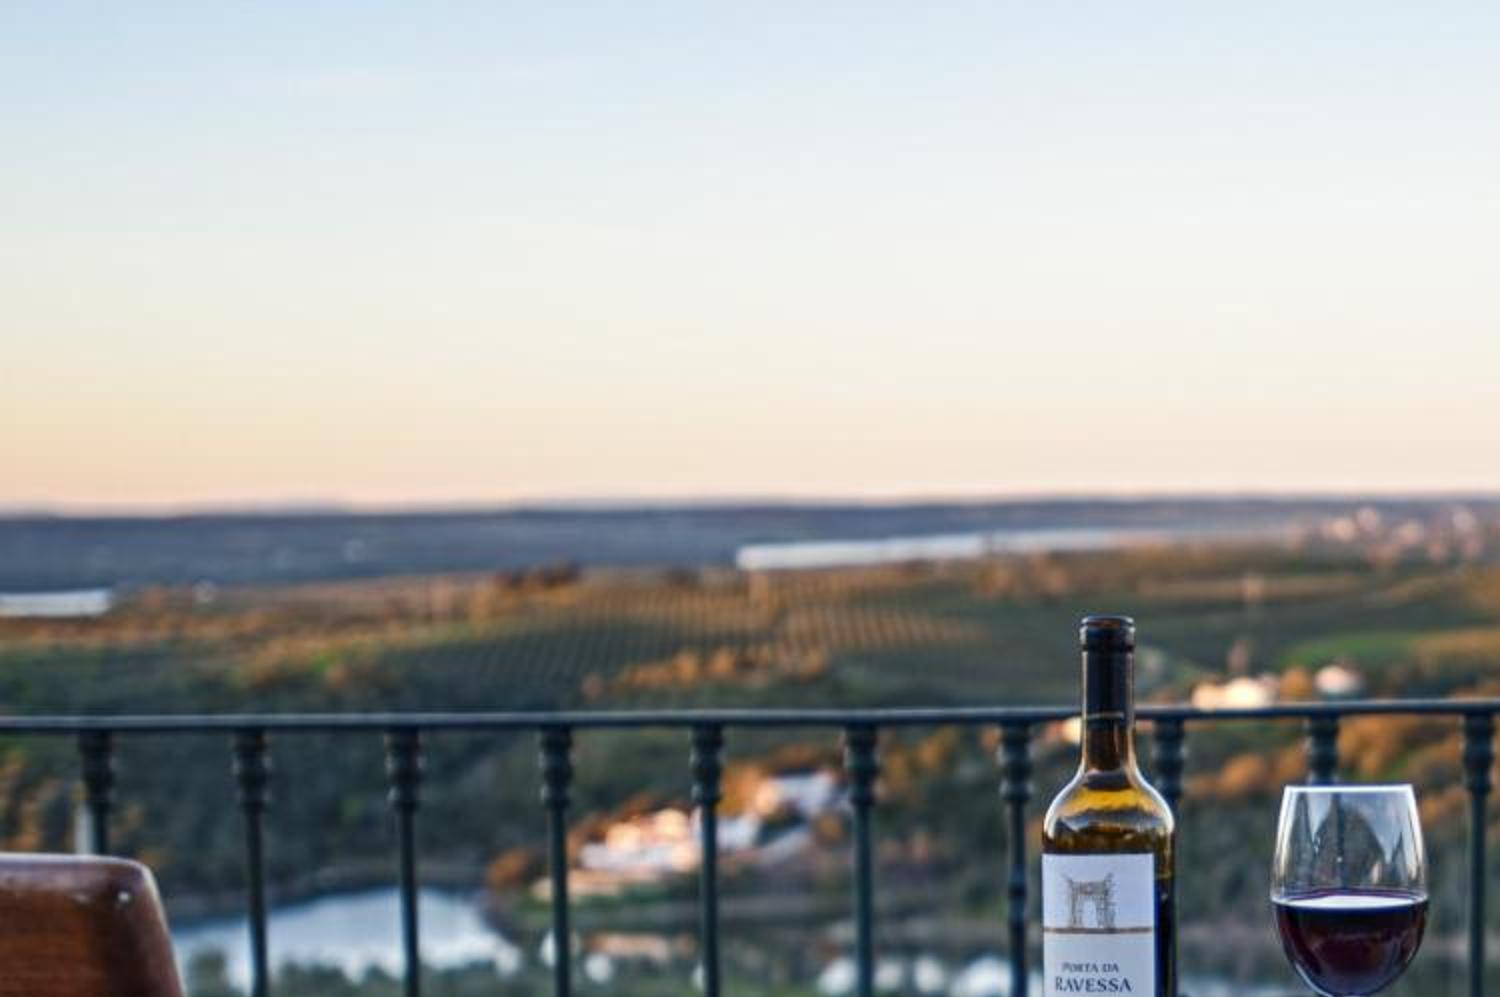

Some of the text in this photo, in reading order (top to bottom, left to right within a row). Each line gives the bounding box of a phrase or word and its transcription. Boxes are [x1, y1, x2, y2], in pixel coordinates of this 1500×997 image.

[1062, 962, 1119, 973] PORTA DA
[1055, 976, 1132, 992] RAVESSA
